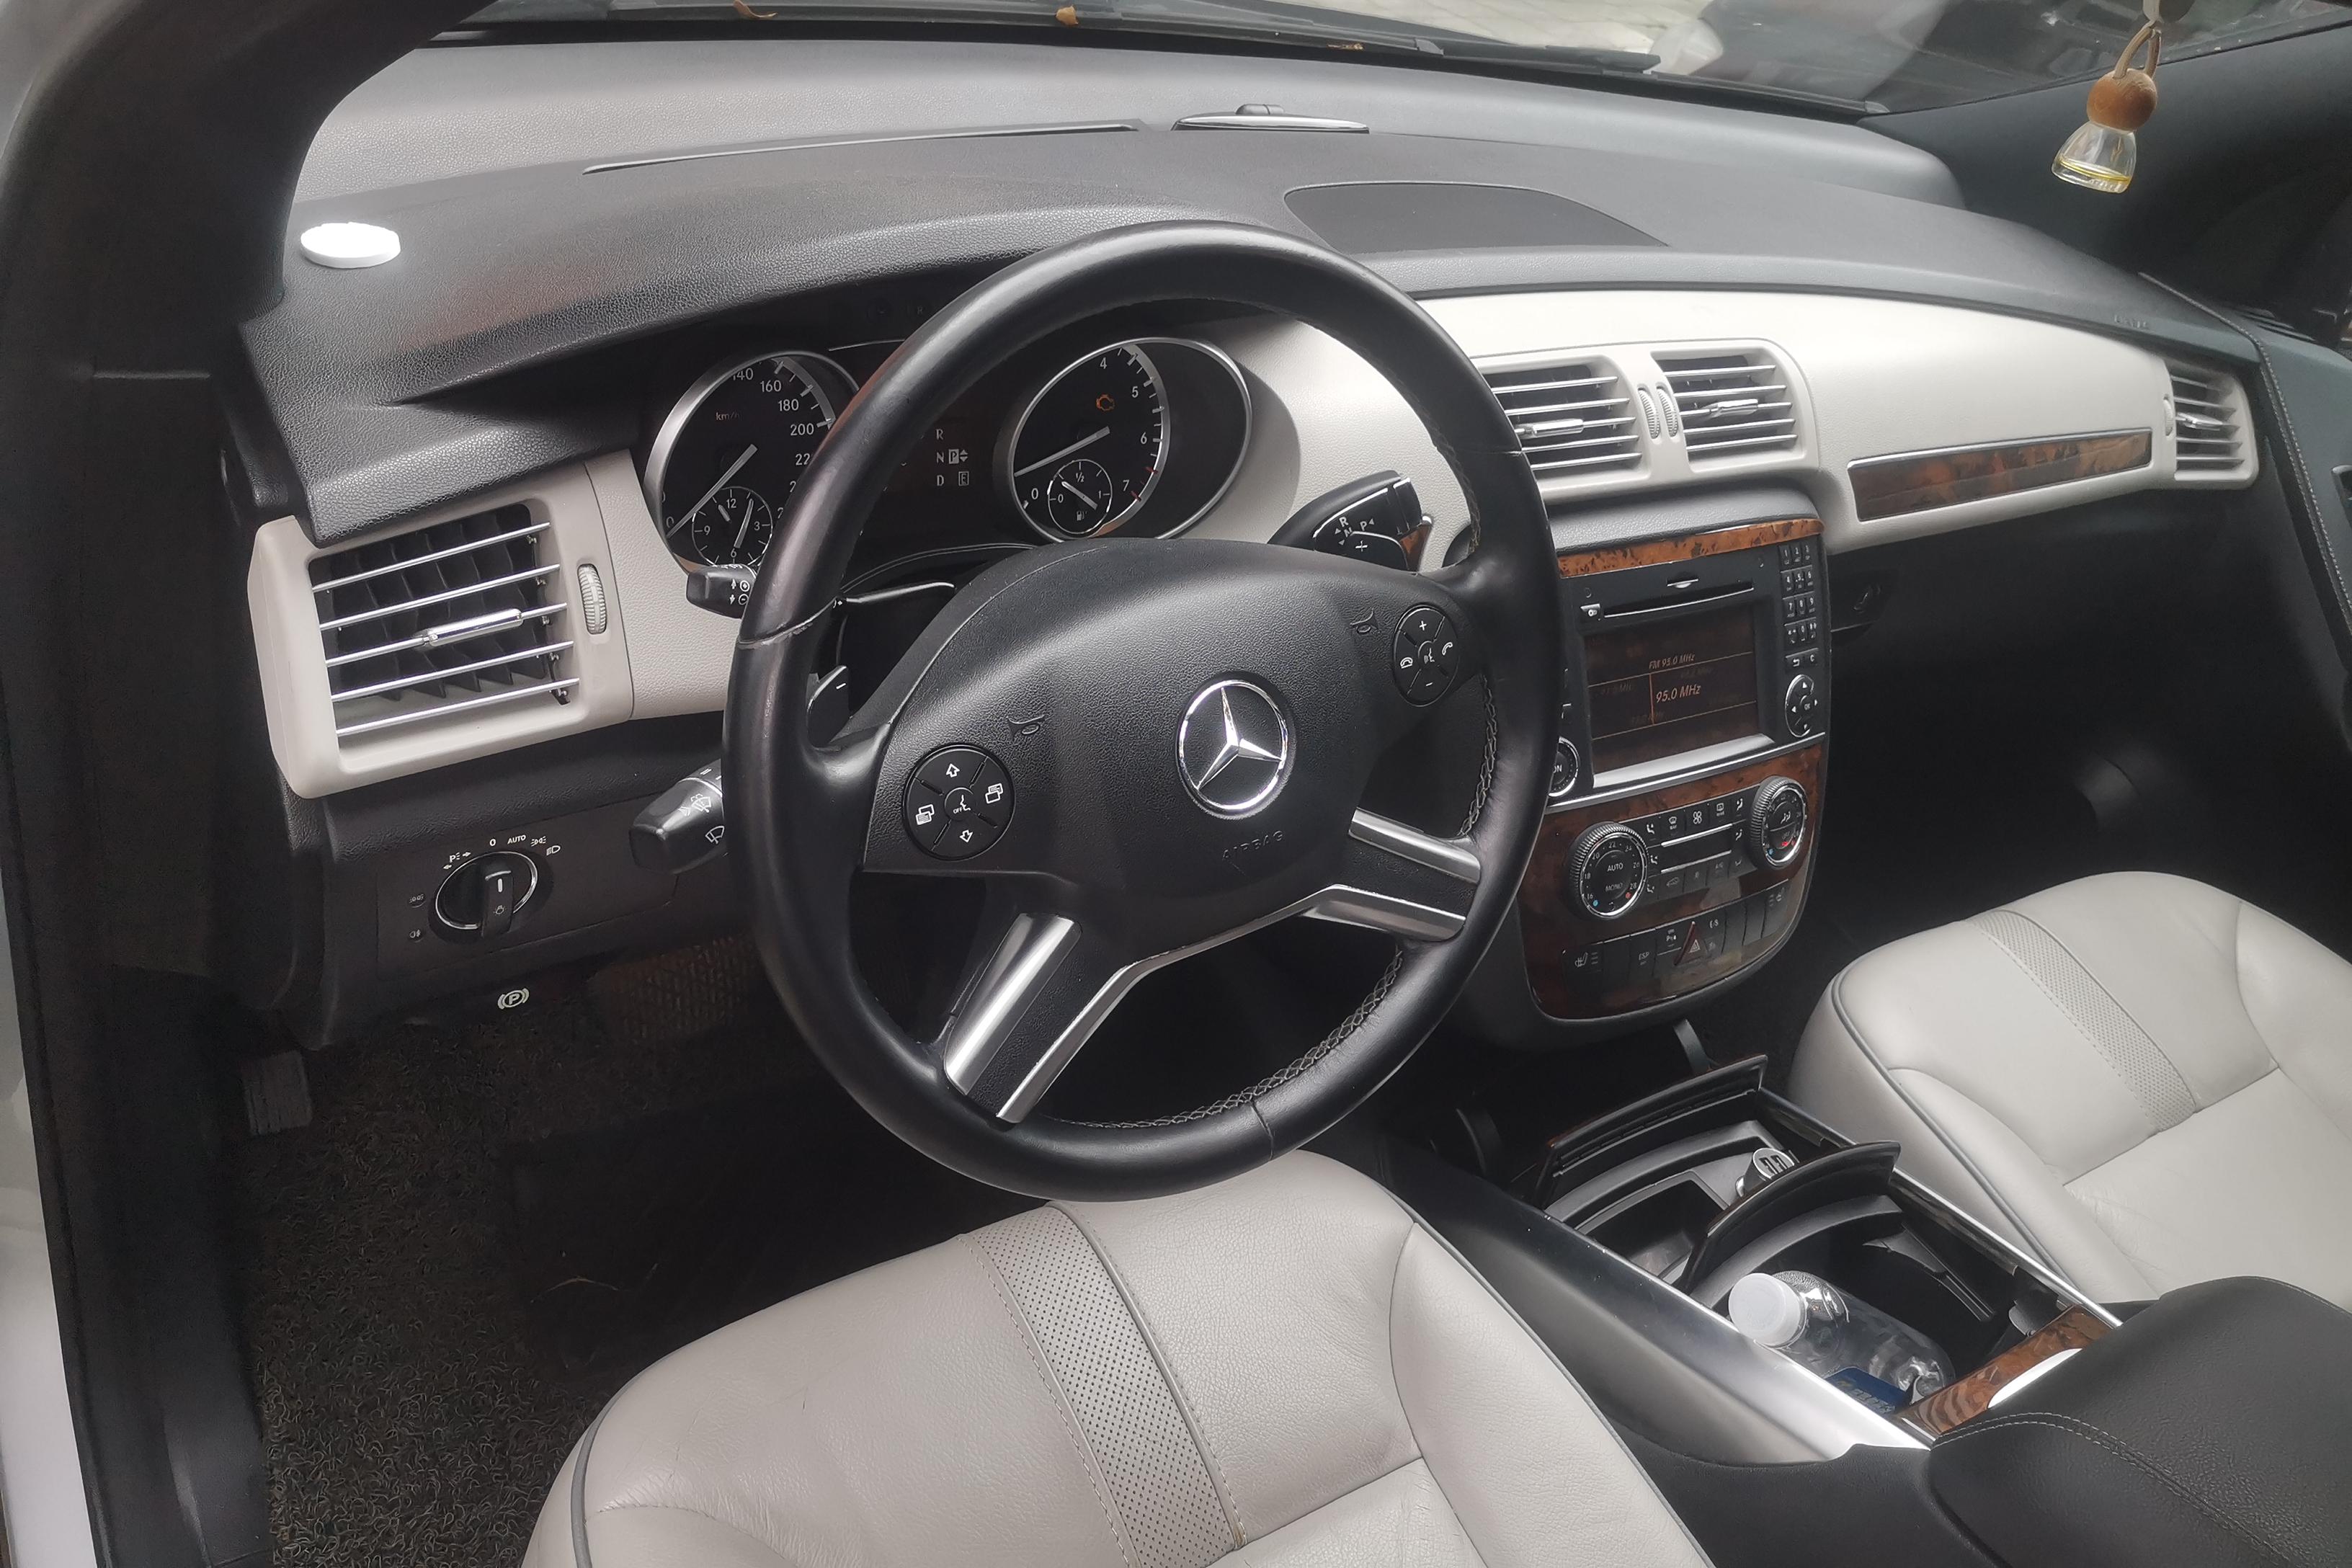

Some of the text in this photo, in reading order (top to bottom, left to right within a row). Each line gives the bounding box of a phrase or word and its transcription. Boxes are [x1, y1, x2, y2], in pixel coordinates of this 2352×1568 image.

[1100, 357, 1107, 369] 4
[760, 380, 782, 393] 160
[1132, 387, 1139, 398] 5
[778, 398, 799, 411] 180
[790, 423, 814, 436] 200
[936, 429, 944, 440] R
[1141, 433, 1147, 444] 6
[795, 453, 812, 466] 22
[937, 452, 944, 463] N
[937, 475, 944, 486] D
[1123, 480, 1130, 491] 7
[1031, 488, 1038, 499] 0
[1058, 494, 1064, 503] 0
[726, 499, 736, 509] 12
[754, 522, 760, 531] 3
[1339, 517, 1349, 527] R
[1360, 521, 1368, 531] P
[703, 525, 710, 535] 9
[731, 548, 737, 558] 6
[1810, 597, 1814, 605] 9
[1656, 684, 1701, 703] 95.0 MHz
[507, 834, 526, 845] AUTO
[1592, 852, 1600, 860] 20
[1607, 863, 1623, 872] AUTO
